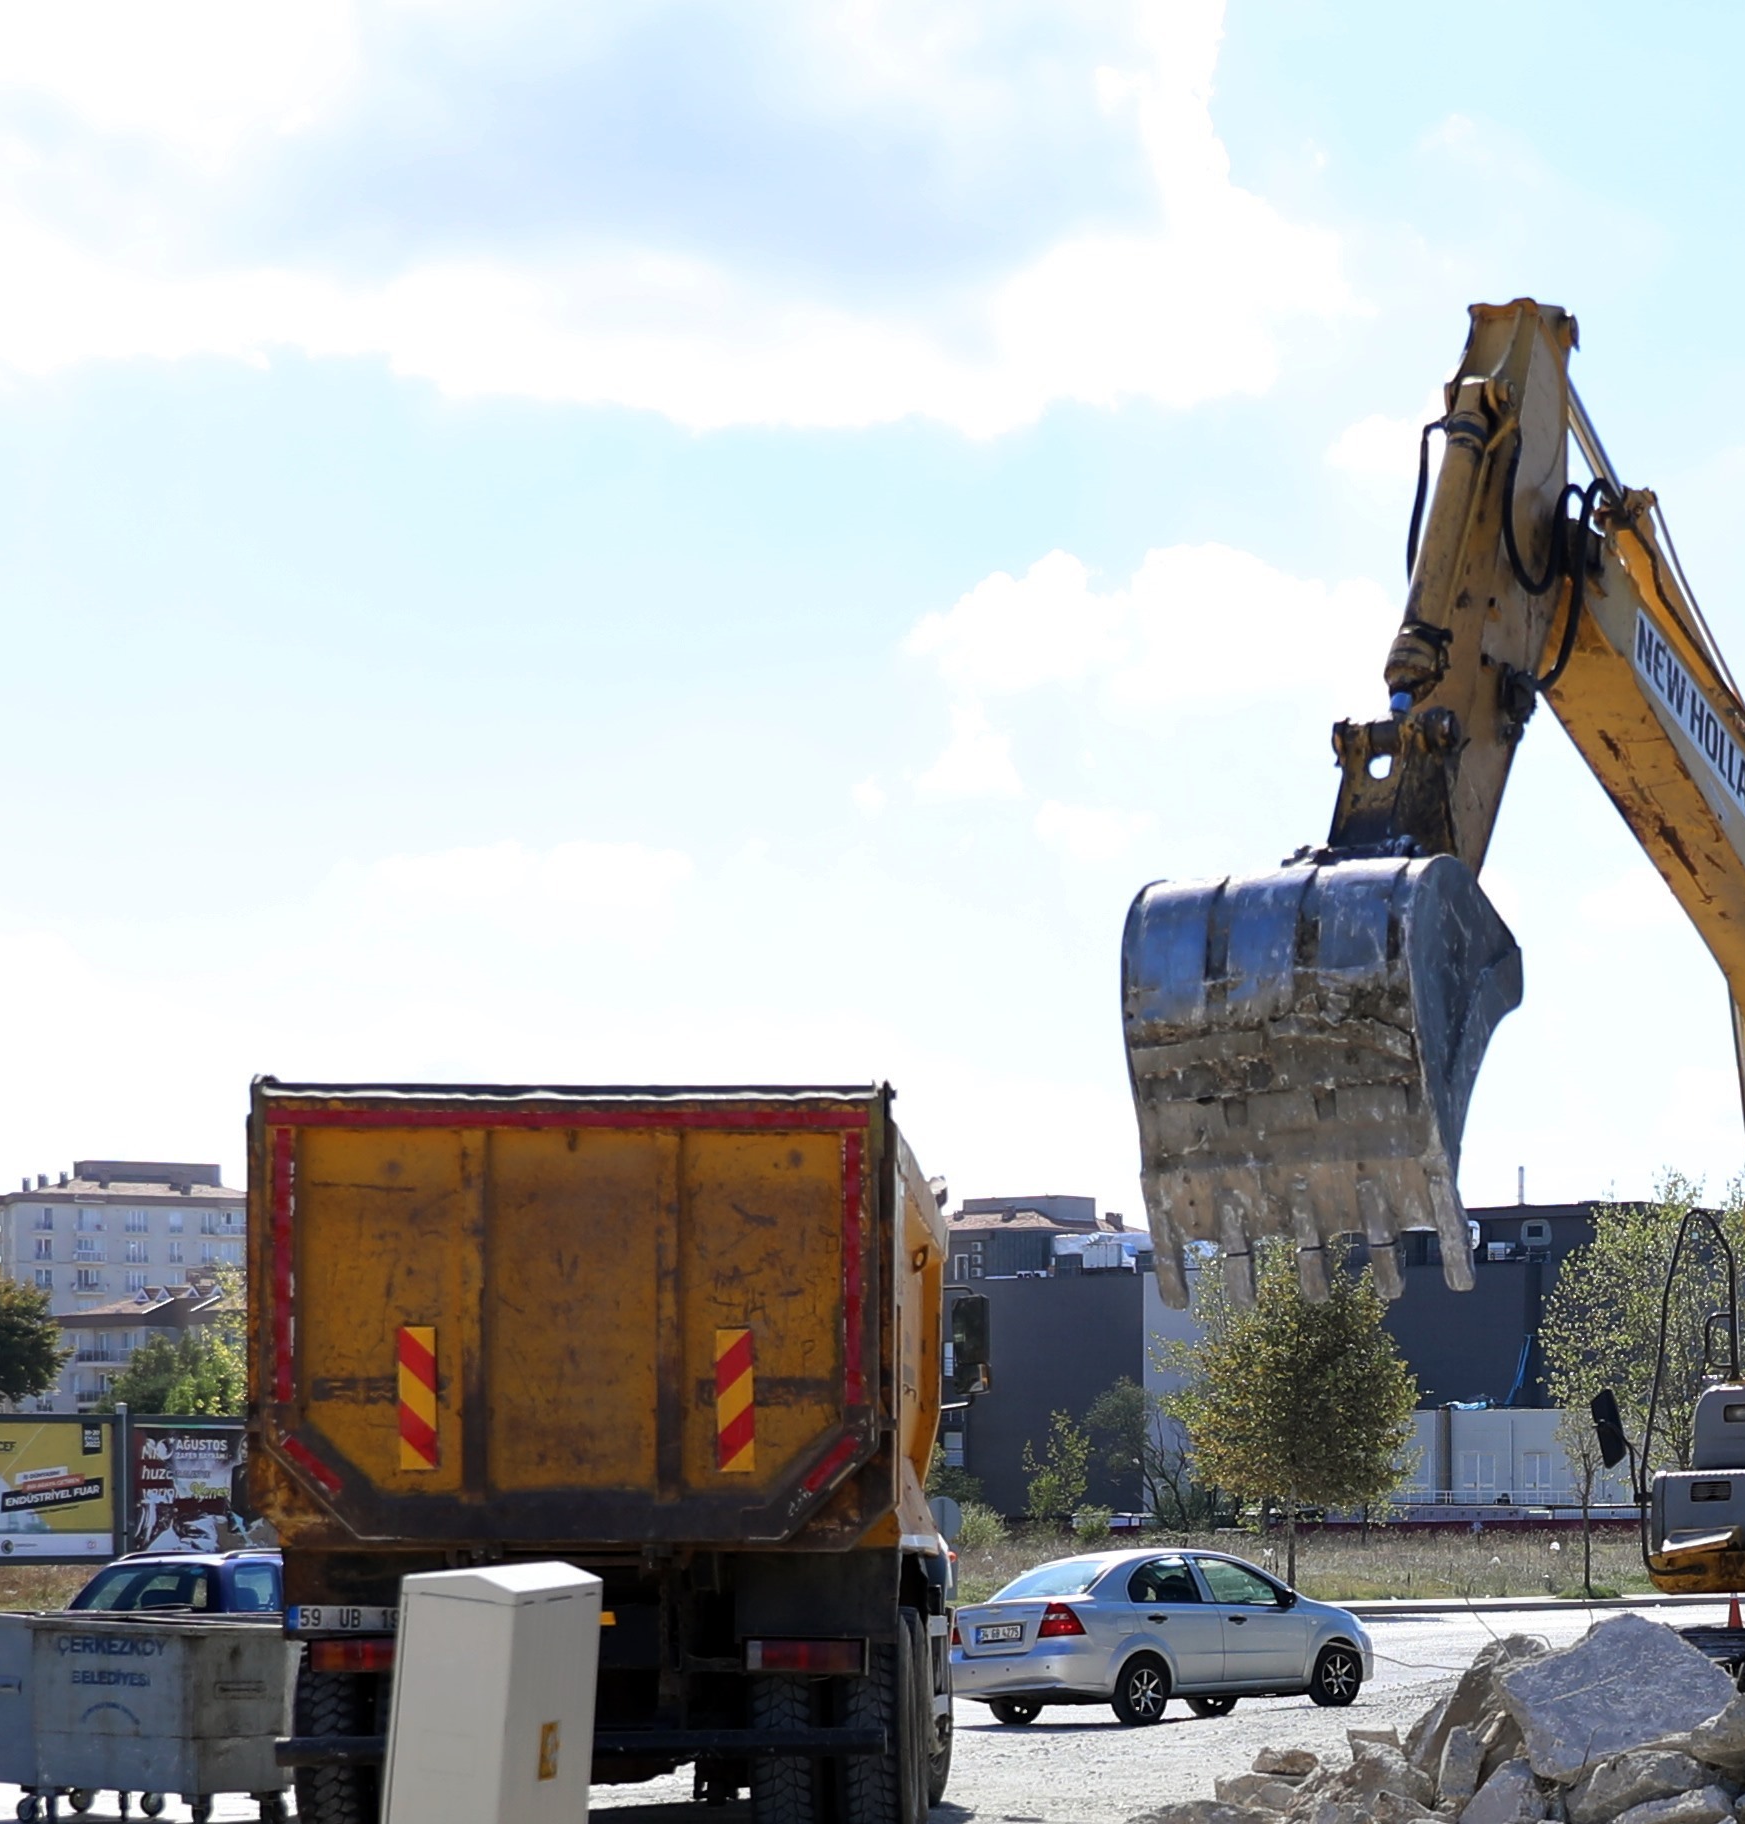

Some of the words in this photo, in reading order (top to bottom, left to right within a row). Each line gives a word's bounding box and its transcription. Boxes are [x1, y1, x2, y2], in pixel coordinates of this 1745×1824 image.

[1637, 617, 1686, 719] NEW
[176, 1435, 228, 1451] AĞUSTOS
[4, 1488, 72, 1507] ENDÜSTRİYEL
[72, 1484, 101, 1497] FUAR
[299, 1607, 323, 1628] 59
[339, 1607, 362, 1629] UB
